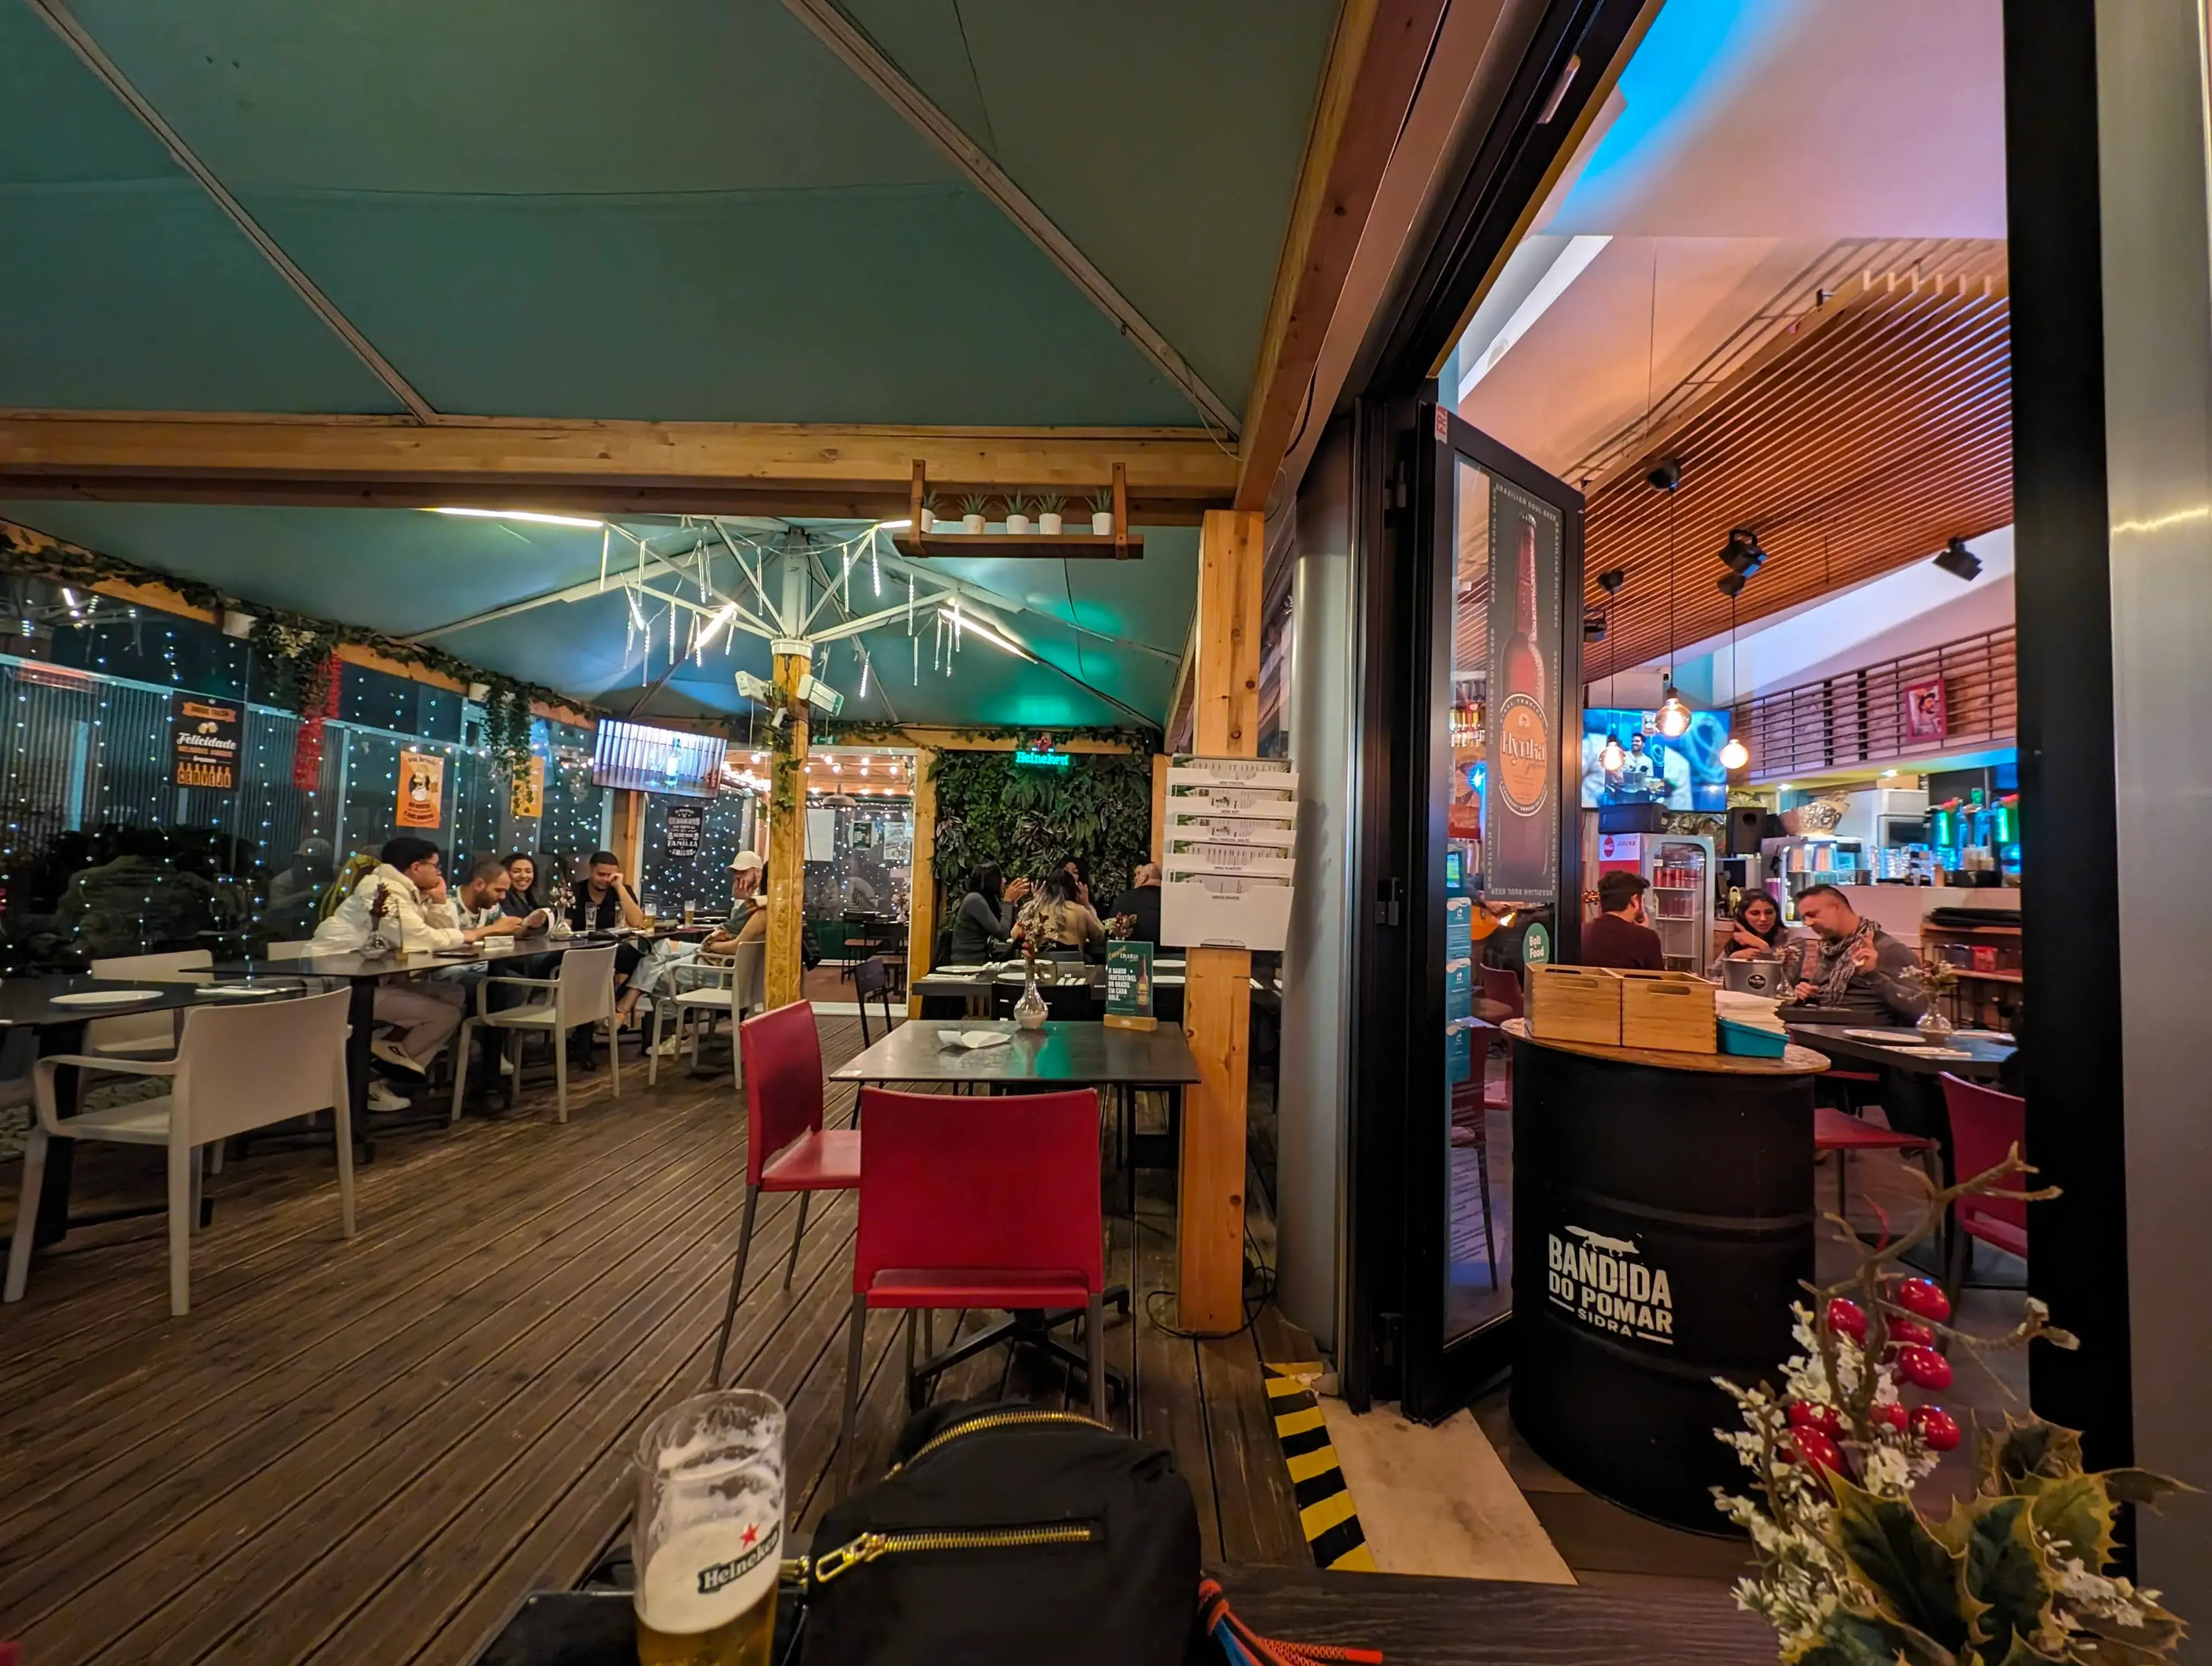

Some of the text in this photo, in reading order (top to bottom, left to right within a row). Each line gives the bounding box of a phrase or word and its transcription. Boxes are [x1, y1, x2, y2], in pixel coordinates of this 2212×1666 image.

[176, 732, 236, 750] Felicidade
[1502, 729, 1546, 765] Hynka
[1015, 752, 1069, 766] Heineken
[178, 766, 232, 787] CERVEJA
[1529, 935, 1541, 946] Bolt
[1529, 946, 1544, 958] Food
[1549, 1233, 1673, 1309] BANDIDA
[1549, 1270, 1673, 1334] DO POMAR
[1578, 1307, 1632, 1337] SIDRA
[704, 1529, 778, 1590] Heineken
